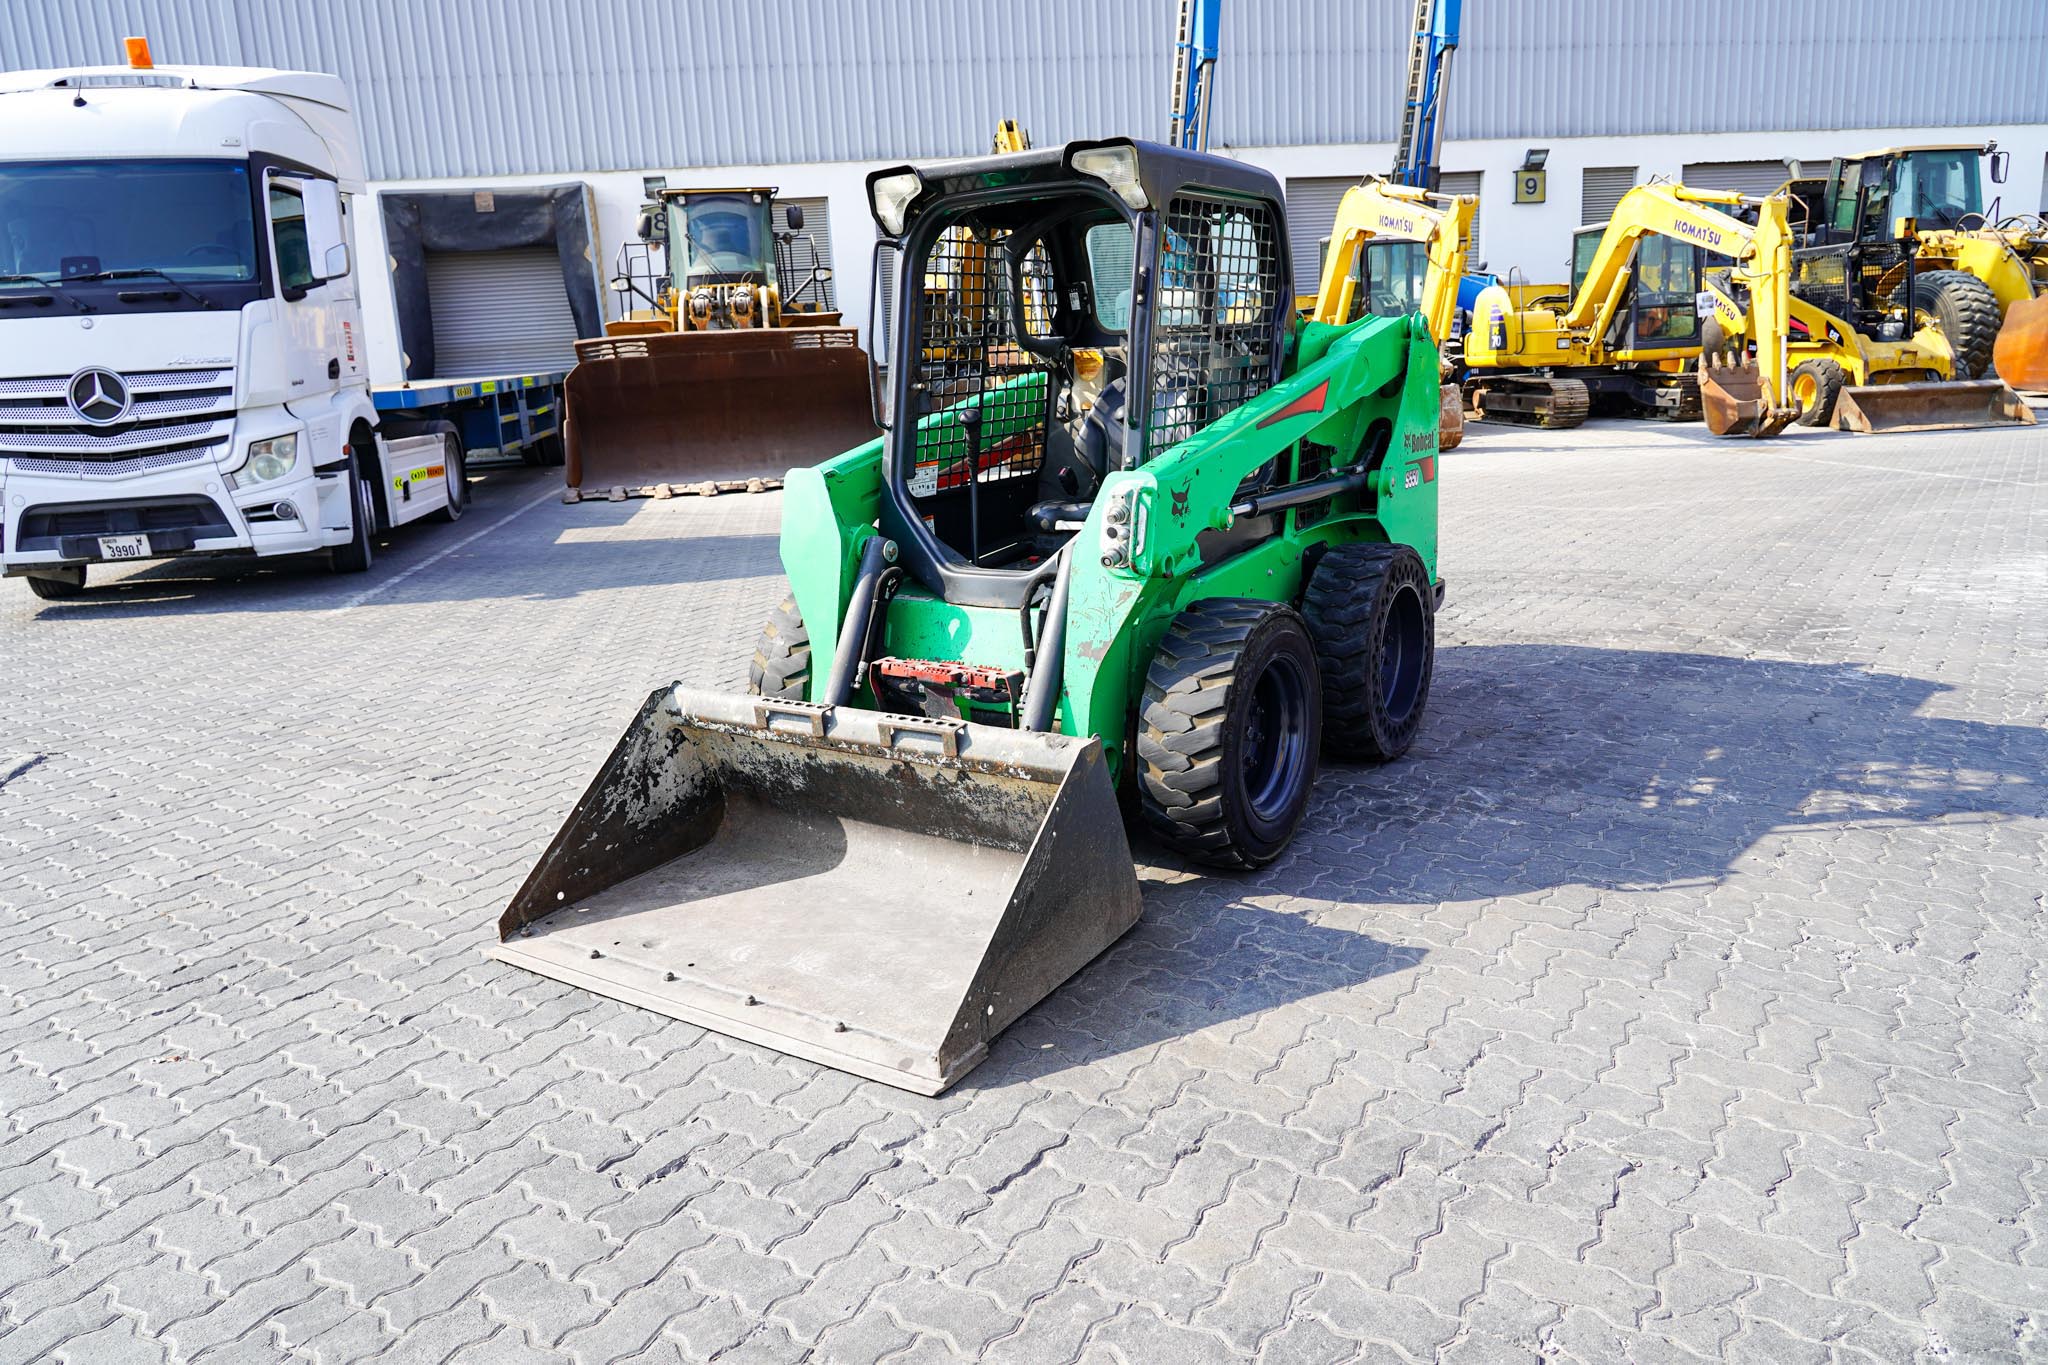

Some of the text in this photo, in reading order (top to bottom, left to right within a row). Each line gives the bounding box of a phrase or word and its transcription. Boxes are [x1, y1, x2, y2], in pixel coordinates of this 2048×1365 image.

[1525, 177, 1538, 195] 9
[654, 212, 667, 231] 8
[1378, 214, 1414, 233] KOMATSU
[1674, 219, 1722, 246] KOMATSU
[1491, 335, 1502, 348] 70
[1411, 431, 1434, 454] Bobcat
[110, 544, 141, 558] 39901
